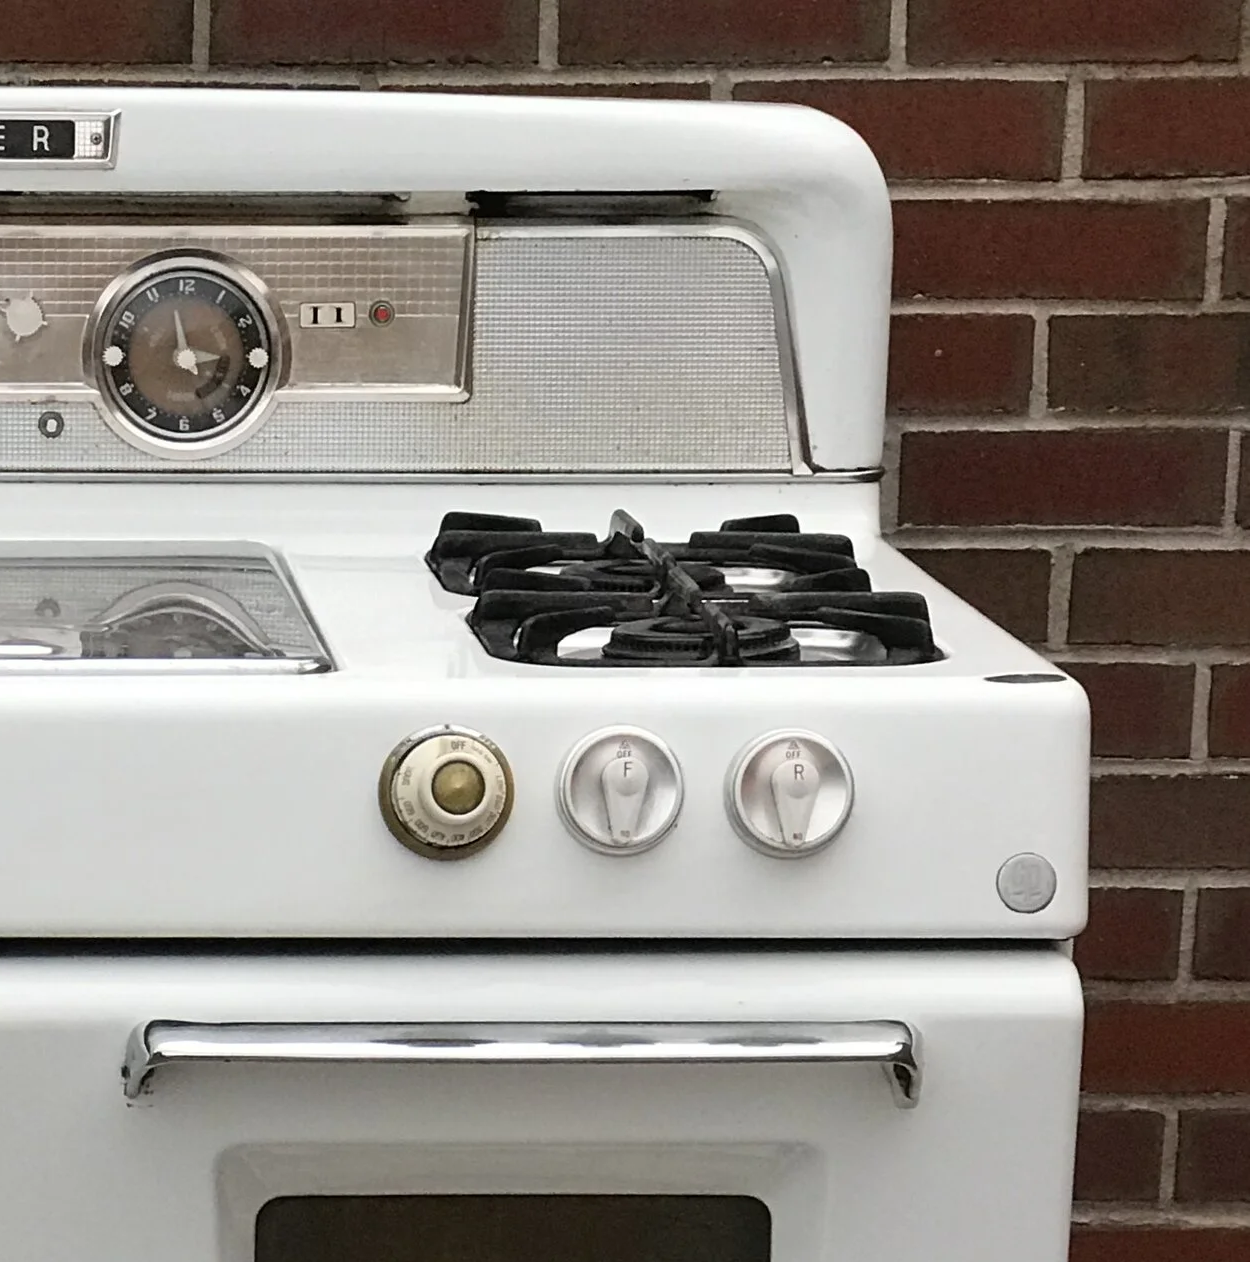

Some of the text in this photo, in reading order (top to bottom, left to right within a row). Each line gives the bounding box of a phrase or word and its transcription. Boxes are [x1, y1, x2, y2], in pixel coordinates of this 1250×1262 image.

[179, 279, 195, 292] 12
[146, 287, 160, 302] 11
[119, 311, 135, 328] 10
[120, 383, 133, 396] 8
[145, 407, 157, 421] 7
[212, 409, 226, 423] 5
[179, 418, 190, 431] 6
[450, 740, 467, 751] OFF
[616, 750, 632, 759] OFF
[785, 750, 801, 759] OFF
[623, 761, 633, 777] F
[794, 763, 805, 780] R
